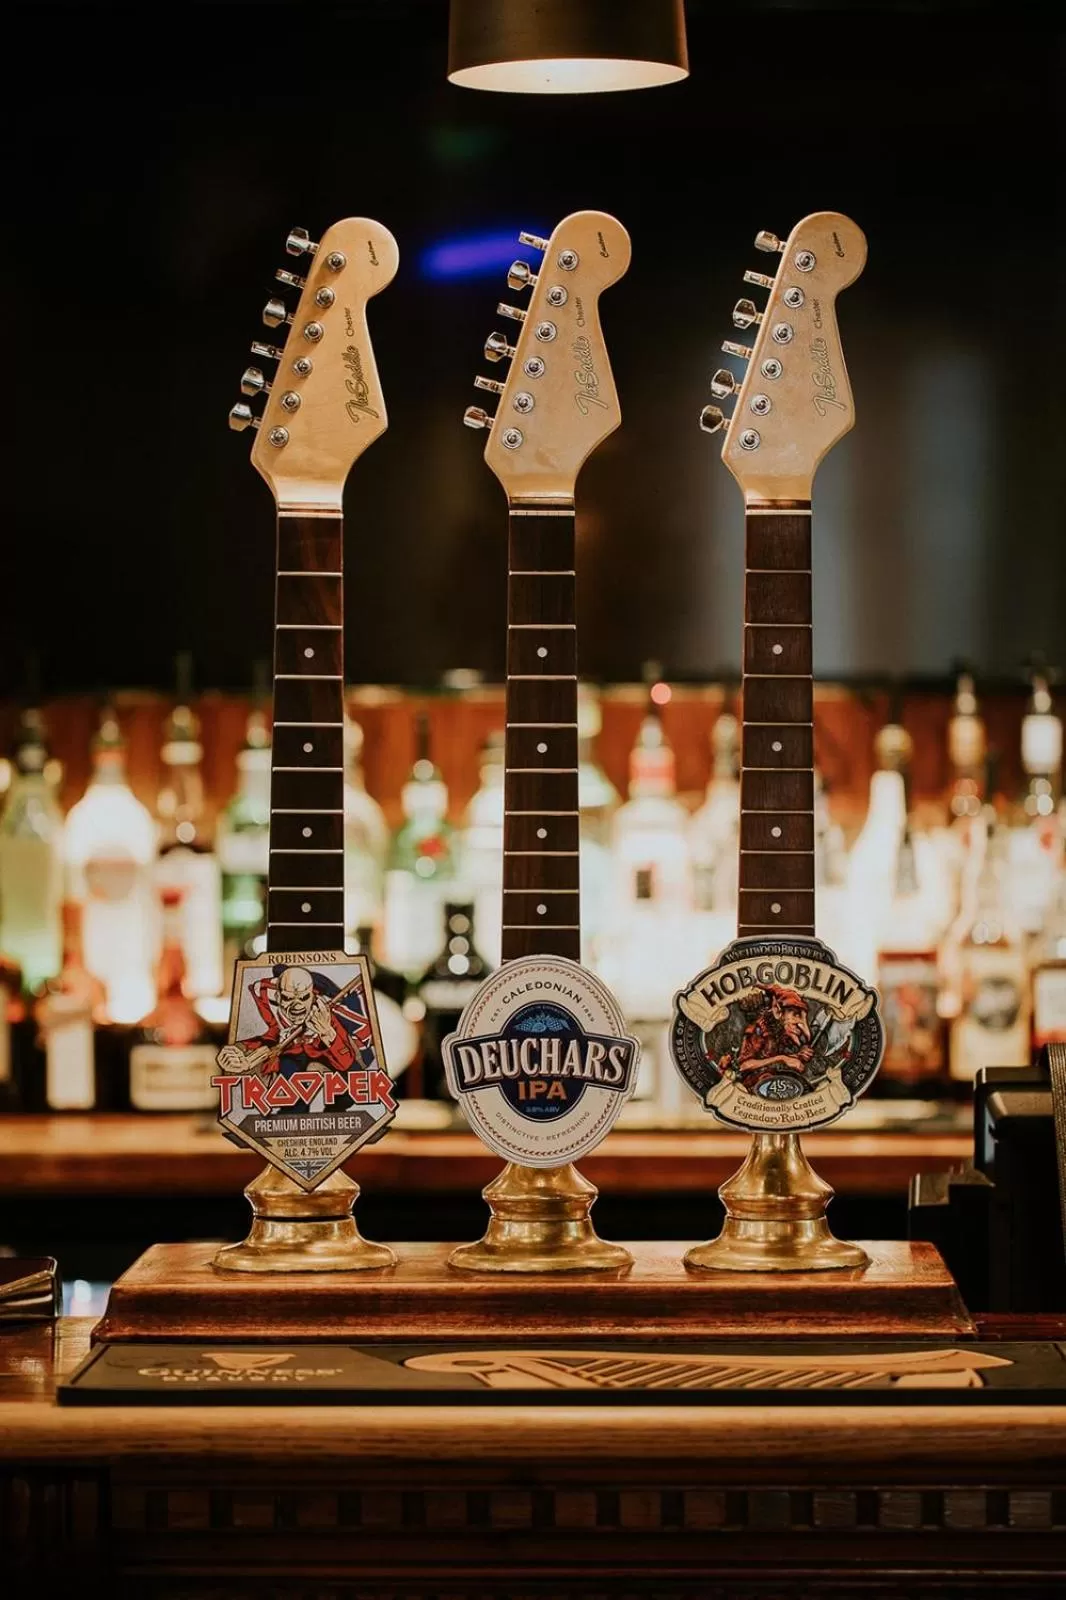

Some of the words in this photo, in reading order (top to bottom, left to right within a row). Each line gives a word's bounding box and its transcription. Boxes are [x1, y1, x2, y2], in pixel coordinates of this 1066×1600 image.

[268, 953, 337, 965] ROBINSONS
[502, 981, 584, 1005] CALEDONIAN
[700, 961, 855, 1008] HOBGOBLIN
[457, 1038, 627, 1084] DEUCHARS
[211, 1070, 398, 1116] TROOPER
[518, 1080, 567, 1100] IPA
[737, 1095, 792, 1112] Traditionally
[792, 1095, 824, 1110] Crafted
[733, 1106, 781, 1124] Legendary
[781, 1112, 805, 1124] Ruby
[805, 1106, 827, 1119] Beer
[254, 1118, 298, 1133] PREMIUM
[300, 1117, 335, 1131] BRITISH
[337, 1116, 362, 1130] BEER
[277, 1138, 308, 1148] CHESHIRE
[309, 1137, 338, 1147] ENGLAND
[284, 1149, 300, 1158] ALC.
[300, 1148, 320, 1157] 4.7%
[137, 1368, 337, 1377] GUINNESS
